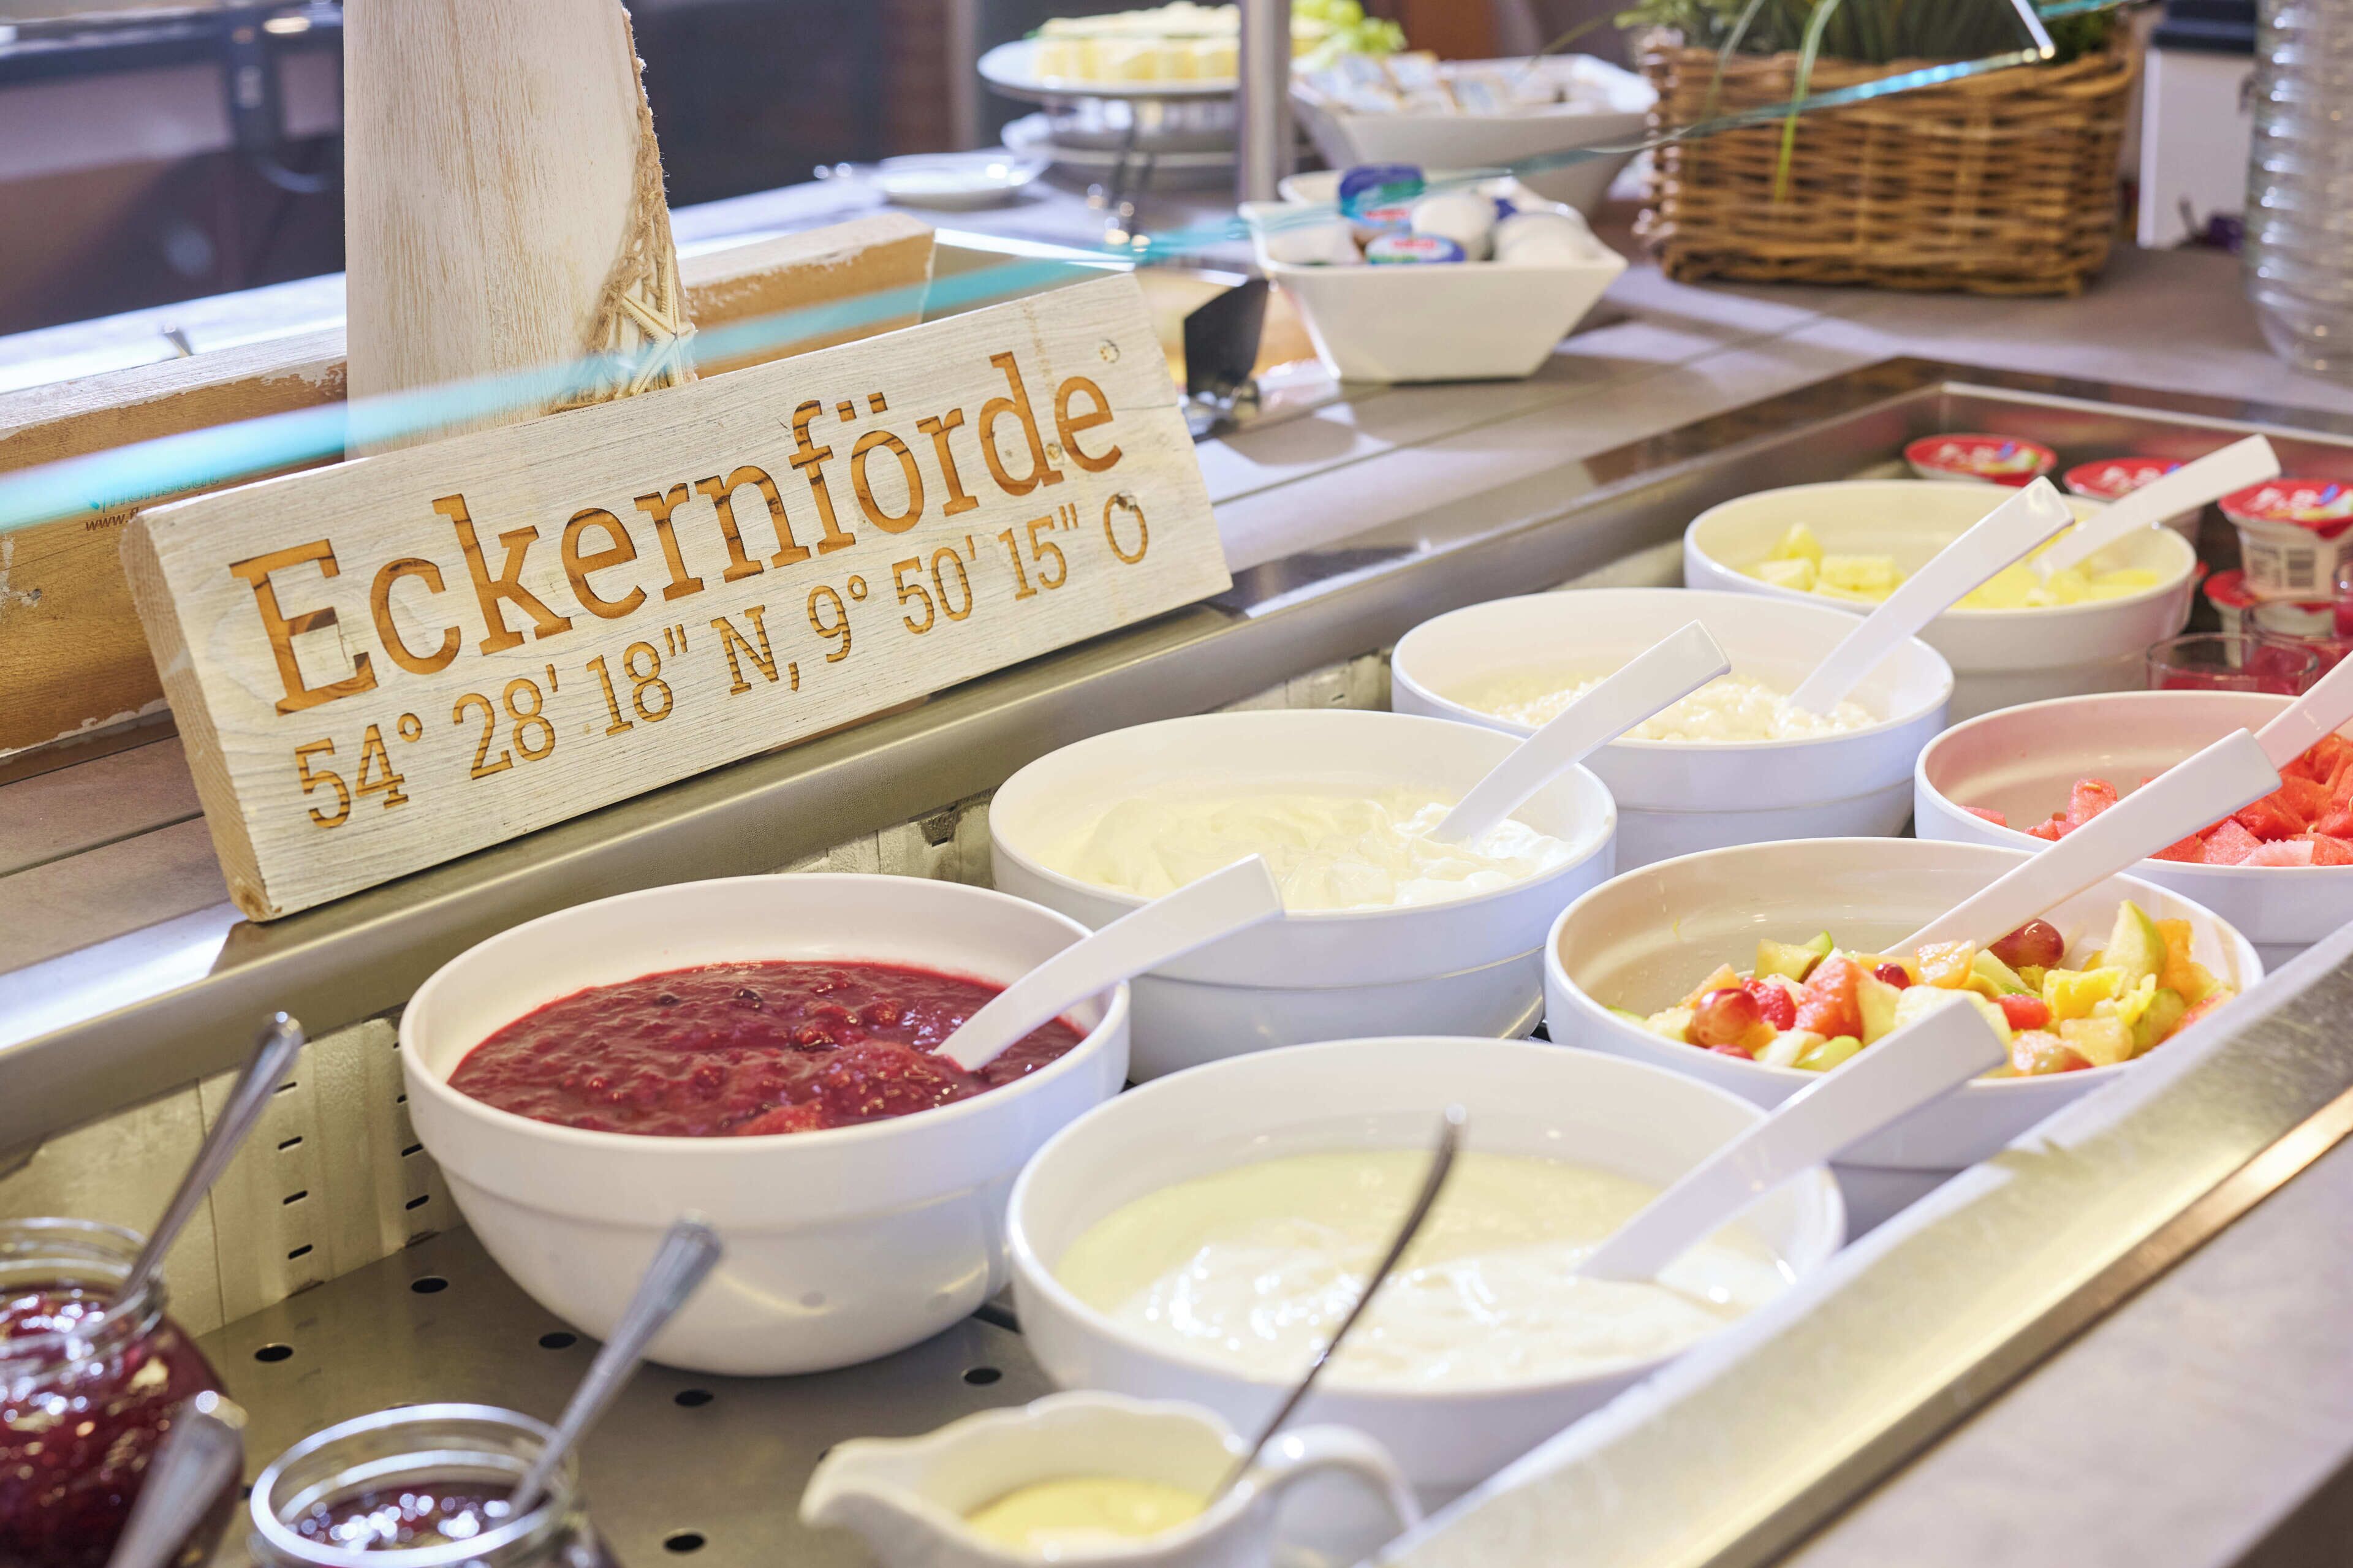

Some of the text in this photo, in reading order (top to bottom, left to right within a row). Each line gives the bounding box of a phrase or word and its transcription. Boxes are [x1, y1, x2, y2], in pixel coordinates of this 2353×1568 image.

[230, 351, 1122, 716] Eckernförde
[295, 492, 1148, 829] 54° 28' 18" N, 9° 50' 15" O
